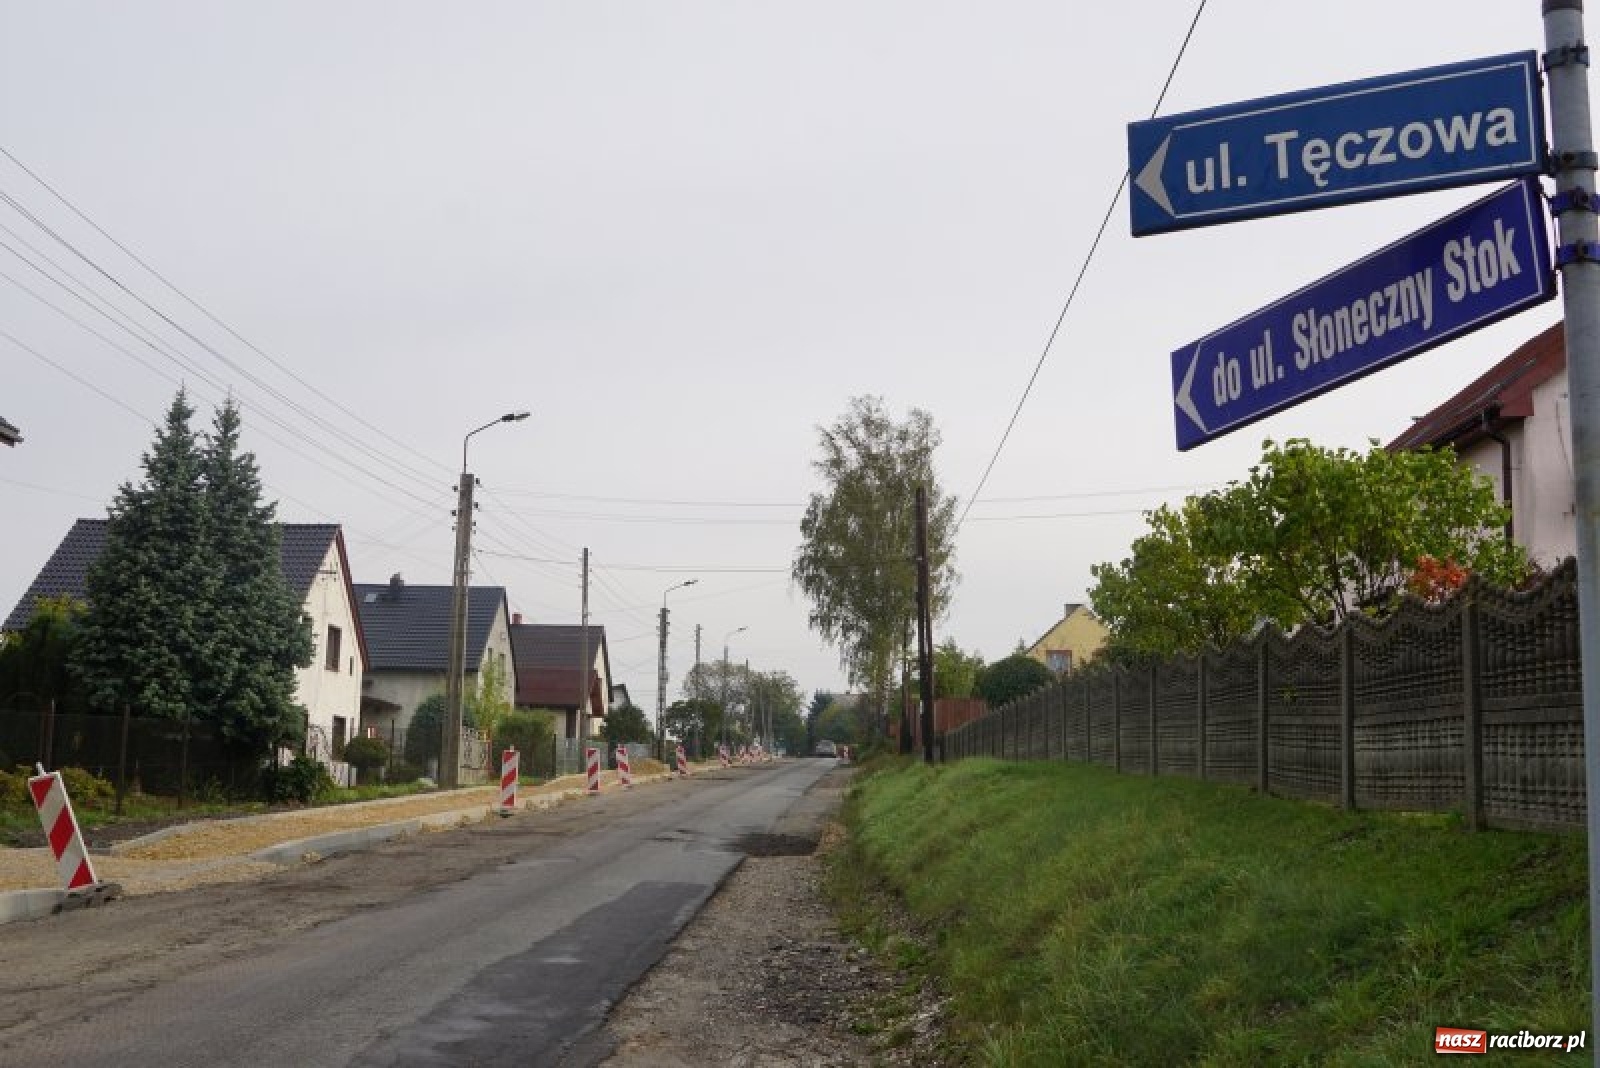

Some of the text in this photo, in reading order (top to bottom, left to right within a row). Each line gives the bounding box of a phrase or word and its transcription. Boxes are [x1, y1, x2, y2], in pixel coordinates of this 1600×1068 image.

[1185, 107, 1518, 194] ul. Tęczowa
[1212, 218, 1521, 407] do ul. Słoneczny Stok
